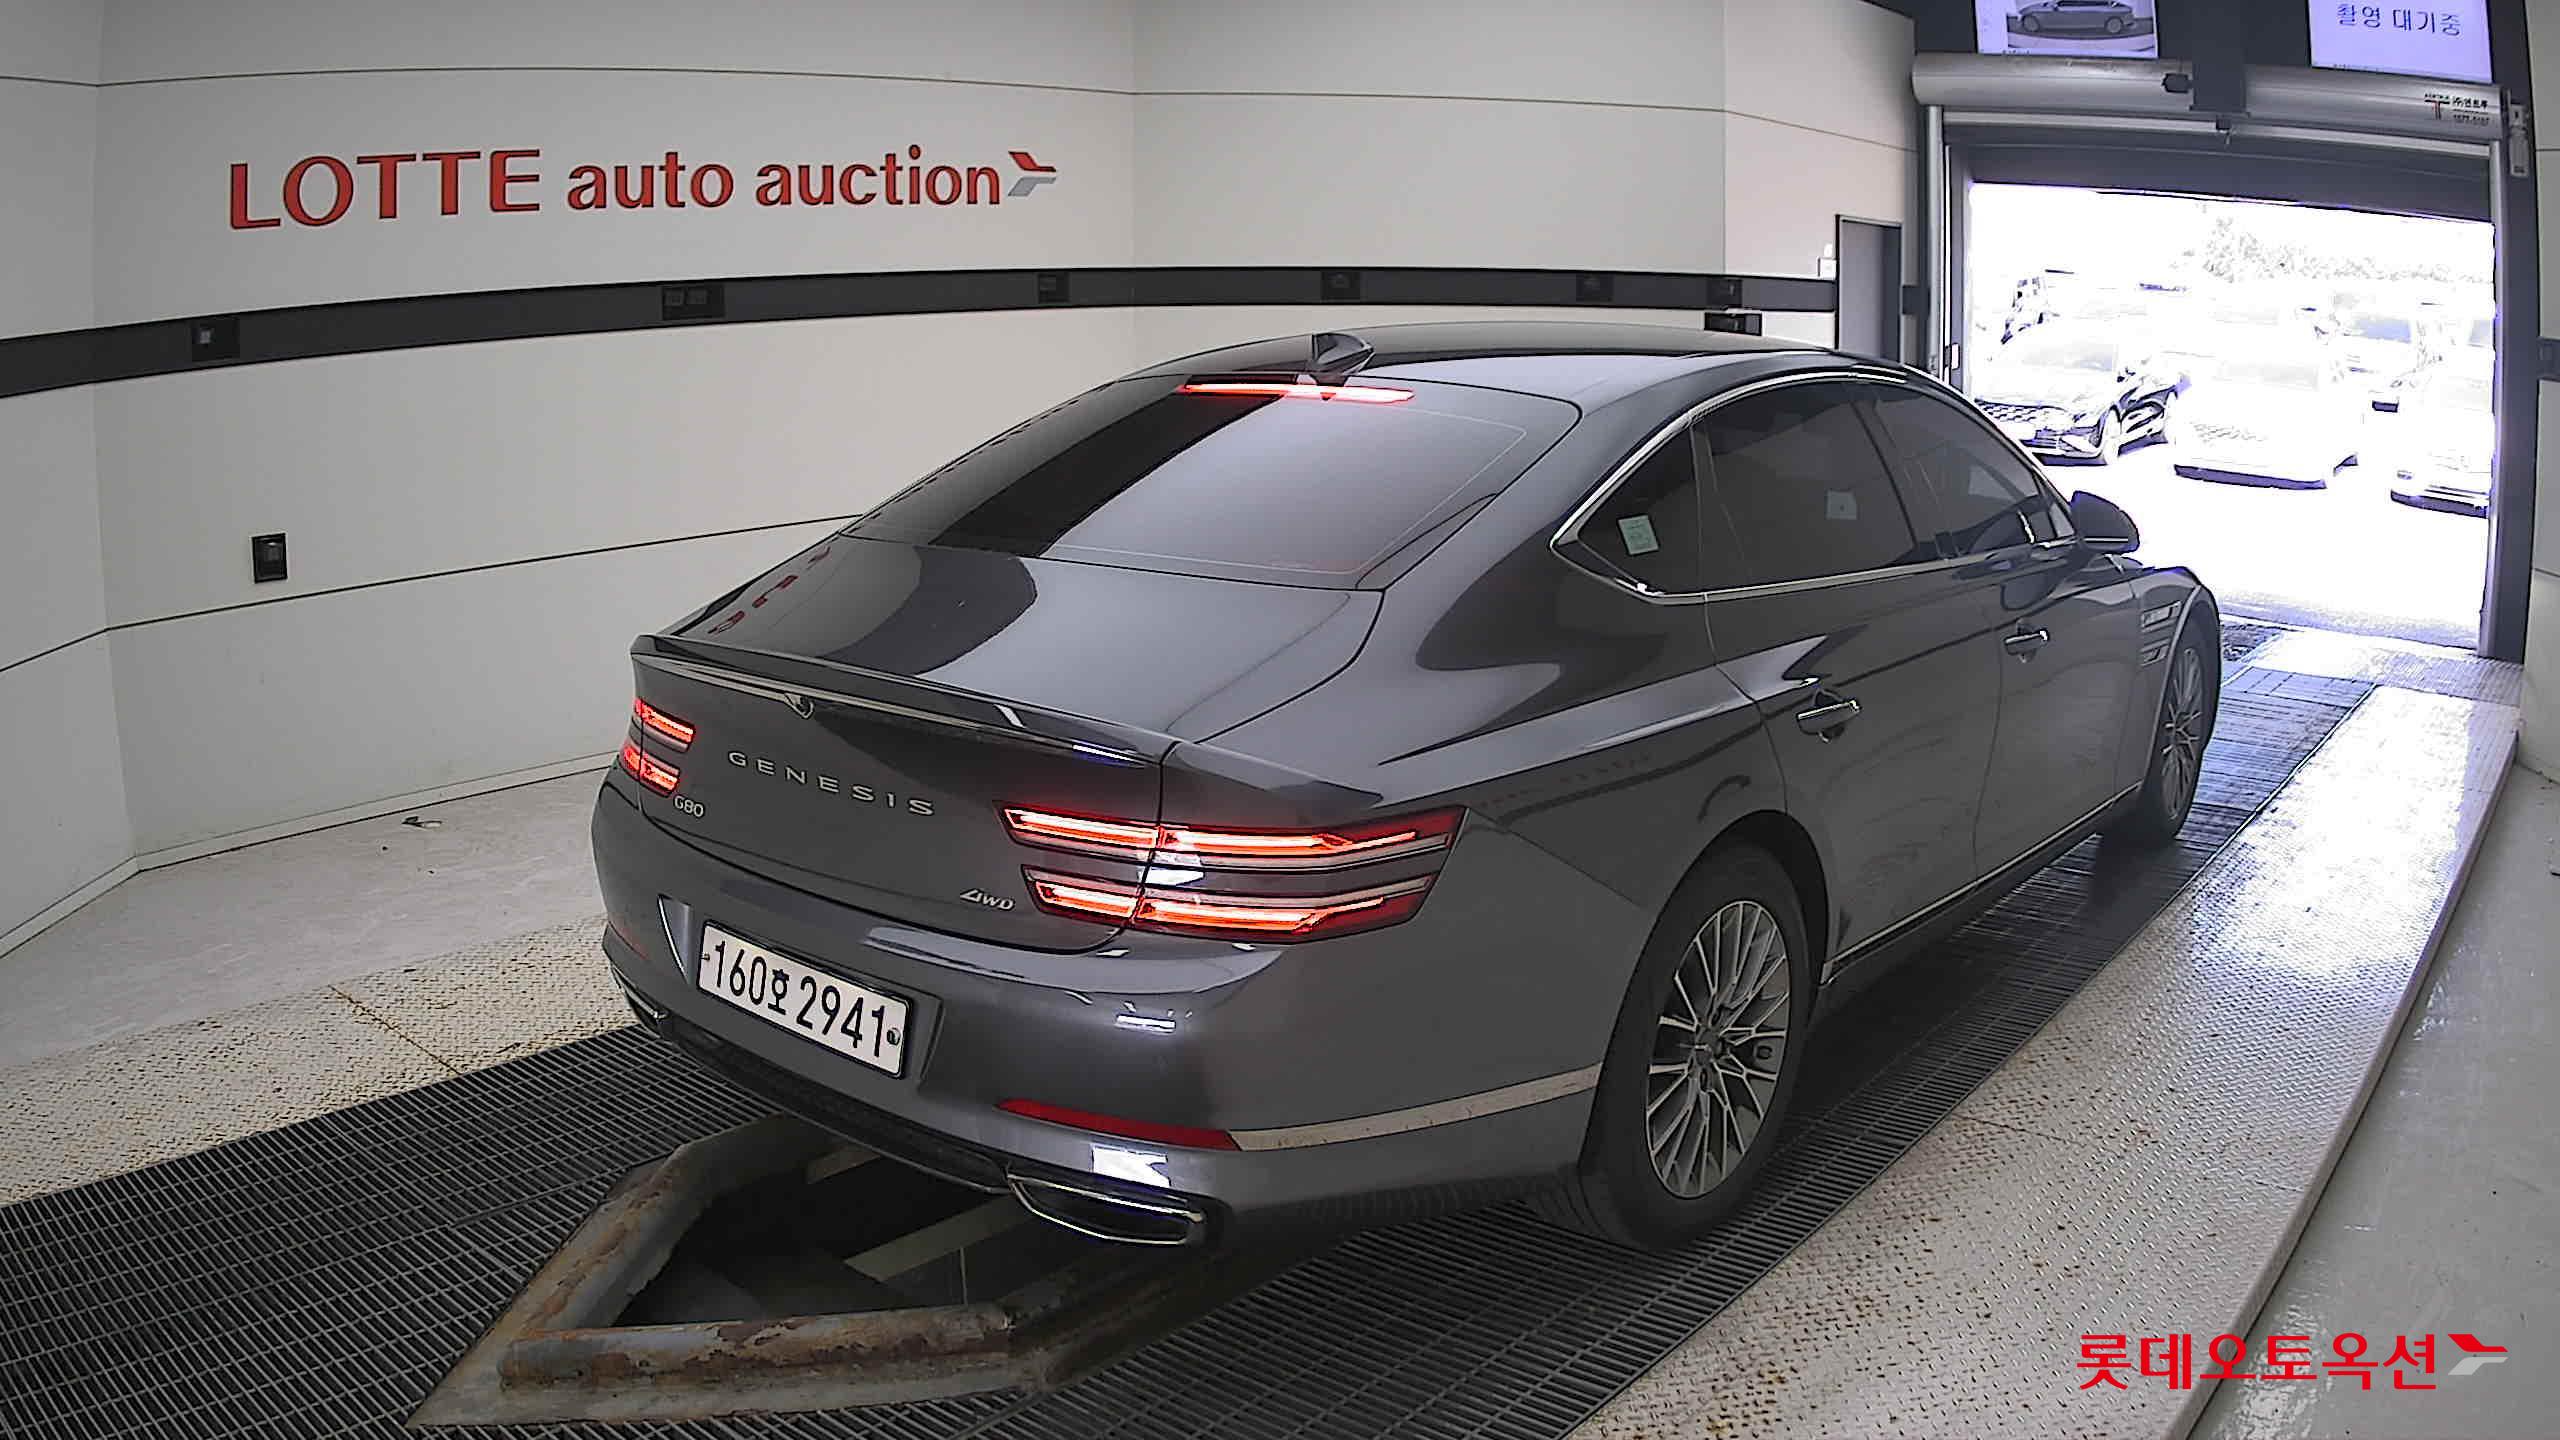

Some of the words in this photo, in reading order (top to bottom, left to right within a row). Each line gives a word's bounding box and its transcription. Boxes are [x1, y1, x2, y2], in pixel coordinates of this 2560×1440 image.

[2337, 3, 2382, 29] 촬영
[2392, 8, 2462, 37] 대기중
[229, 149, 541, 230] LOTTE
[567, 152, 734, 210] auto
[756, 145, 1001, 210] auction
[674, 794, 704, 818] G80
[728, 750, 935, 817] GENESIS
[714, 940, 790, 1016] 160호
[796, 975, 886, 1058] 2941
